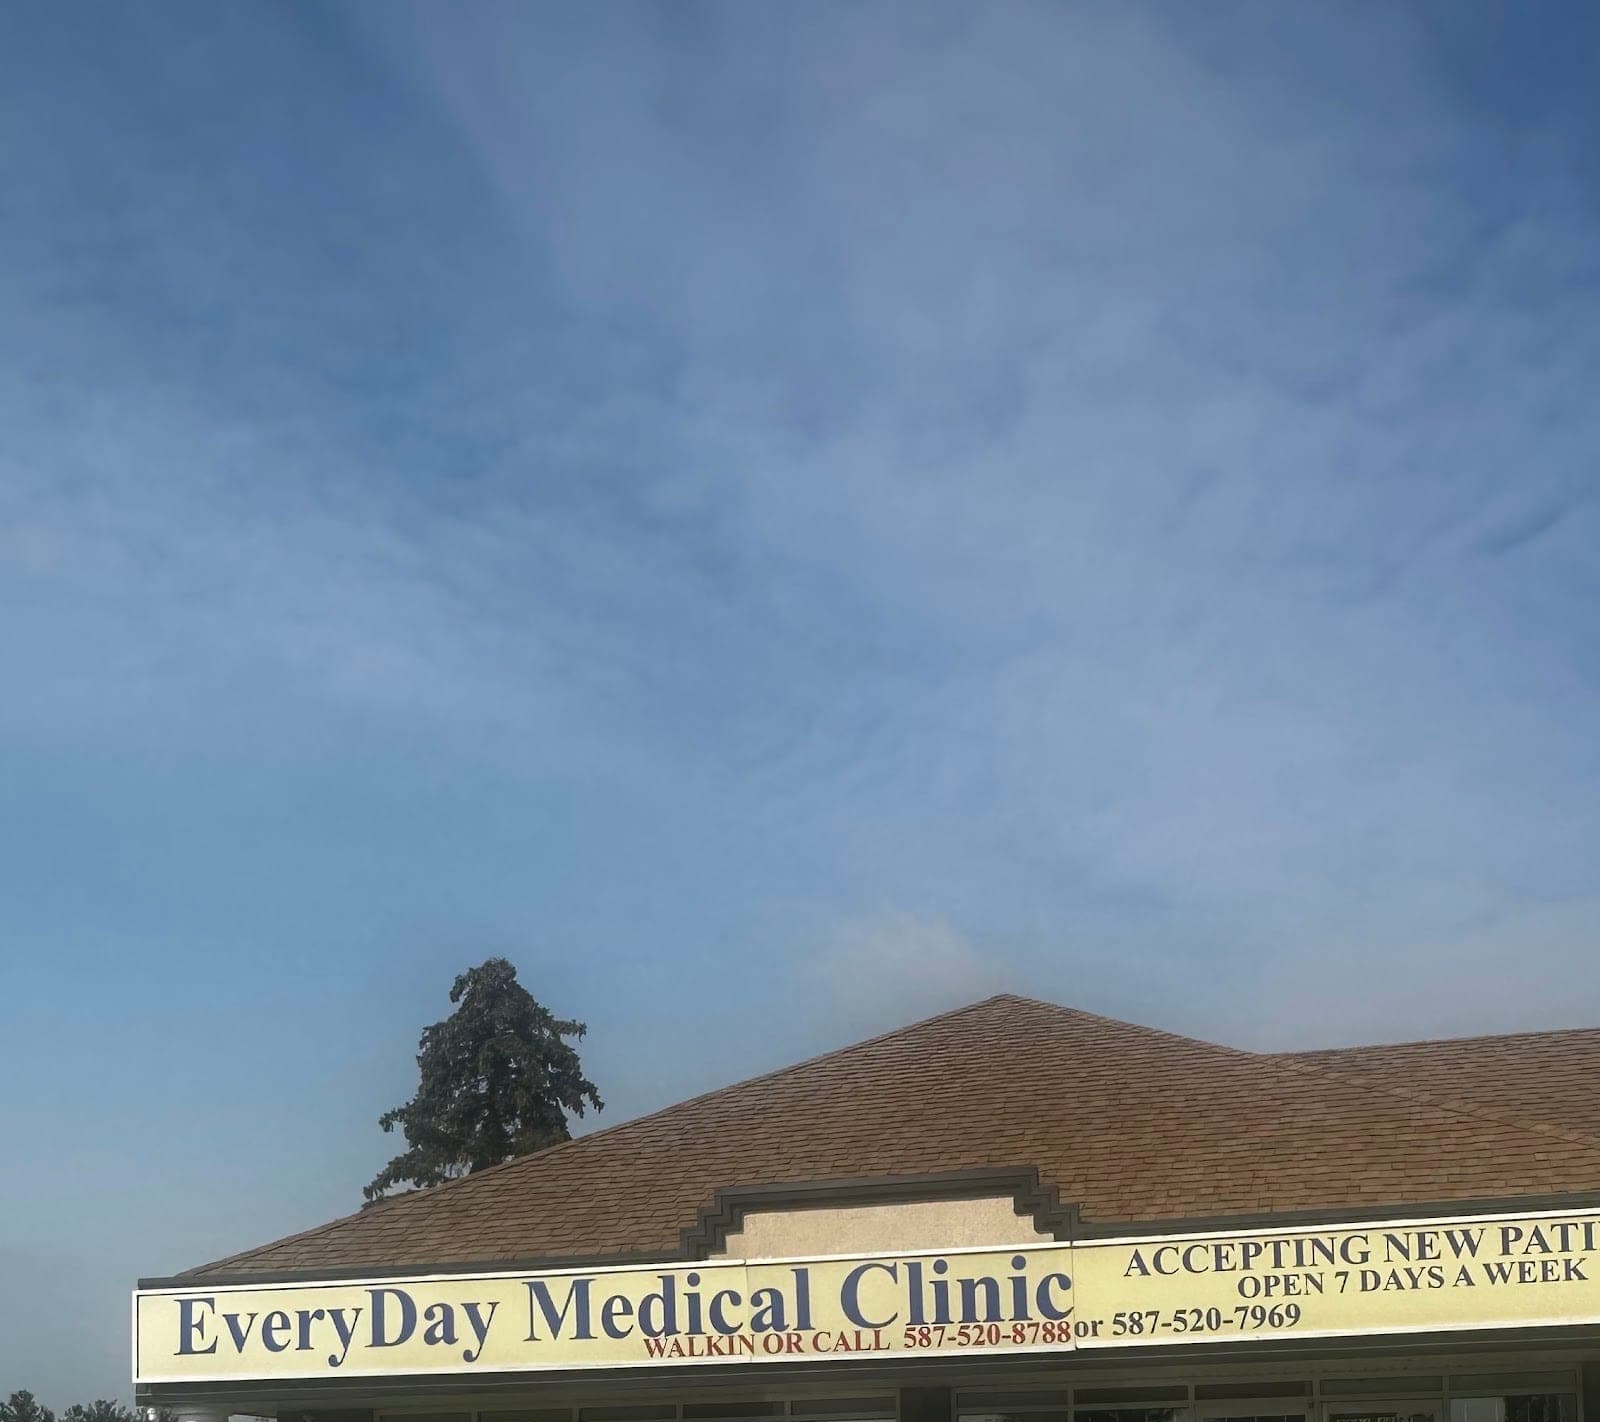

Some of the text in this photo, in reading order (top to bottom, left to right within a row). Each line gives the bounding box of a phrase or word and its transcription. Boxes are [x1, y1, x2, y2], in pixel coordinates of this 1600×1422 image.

[1123, 1220, 1600, 1278] ACCEPTING NEW PATI
[1237, 1257, 1589, 1299] OPEN 7 DAYS A WEEK
[173, 1255, 1075, 1368] EveryDay Medical Clinic
[643, 1303, 1302, 1358] WALKIN OR CALL 587-520-8788 or 587-520-7969
